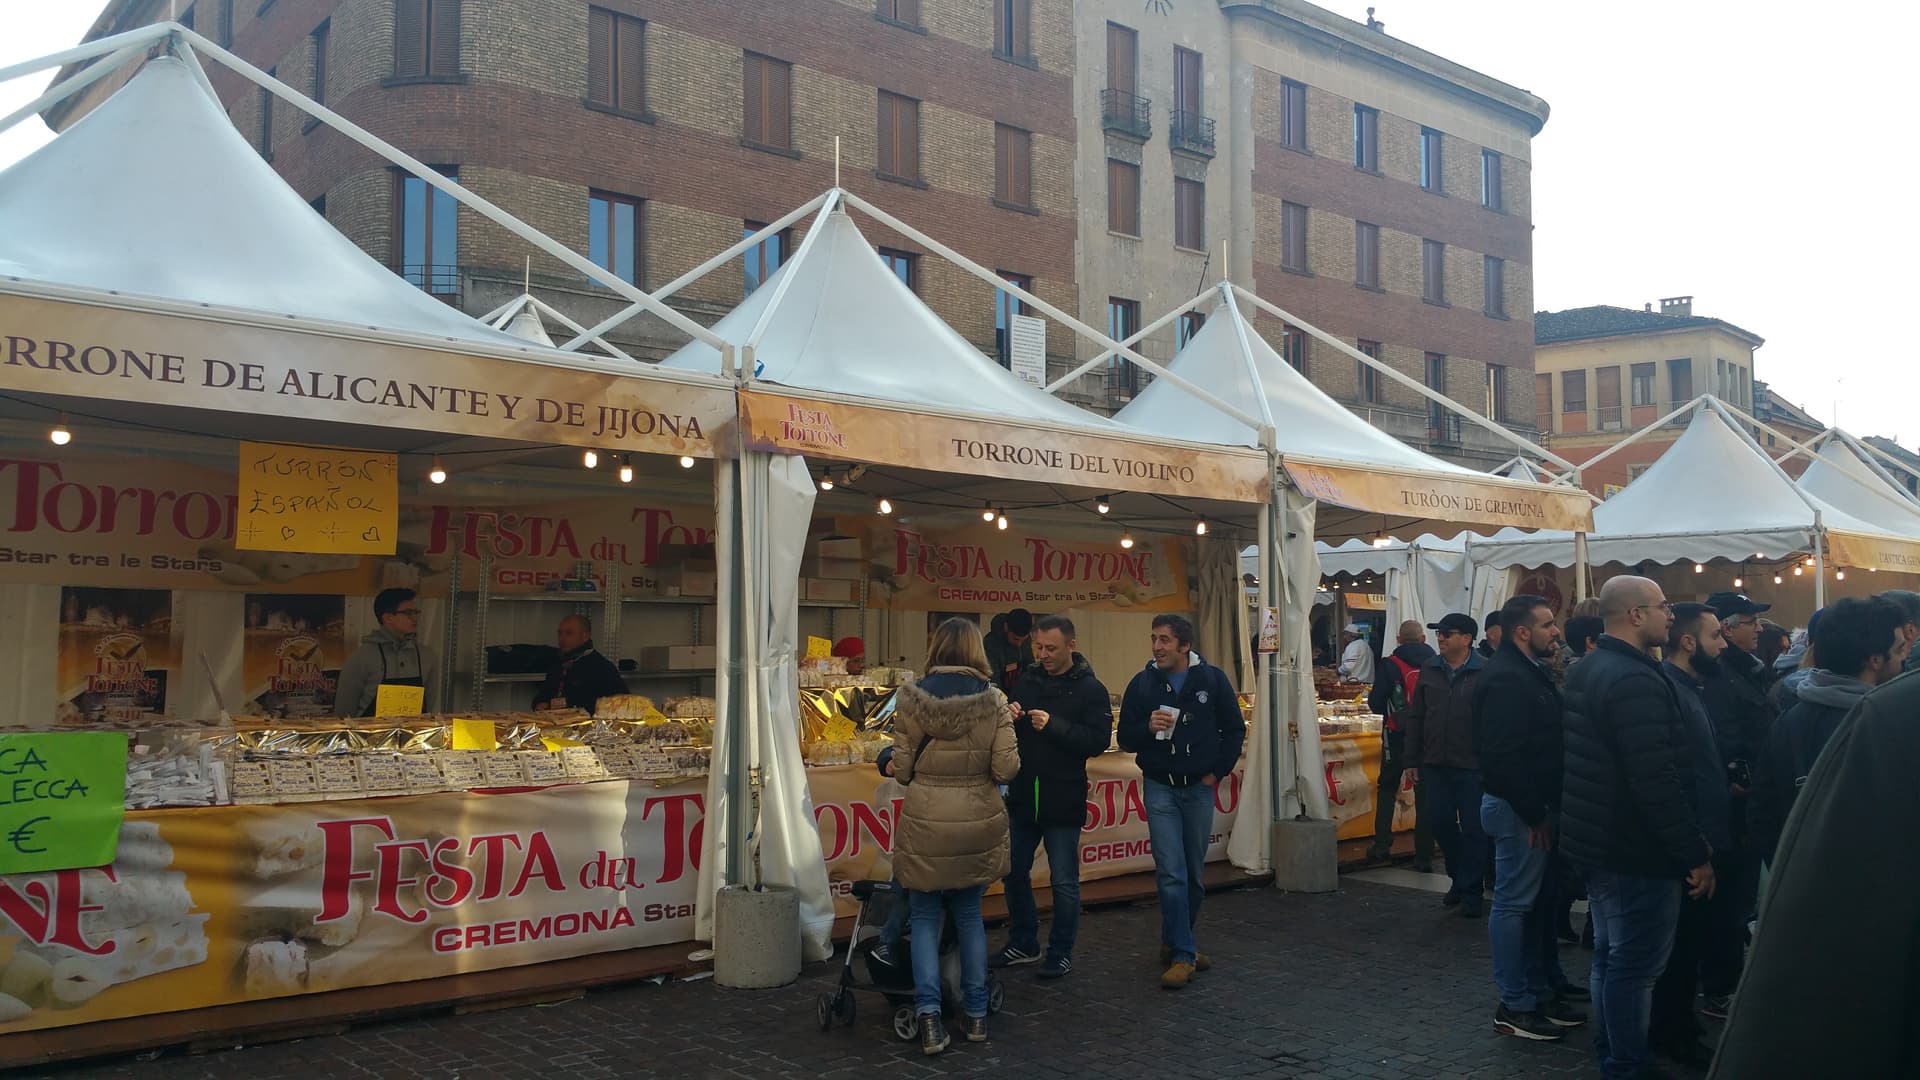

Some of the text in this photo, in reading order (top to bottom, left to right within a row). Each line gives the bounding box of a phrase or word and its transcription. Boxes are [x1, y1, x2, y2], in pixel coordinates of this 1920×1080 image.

[0, 335, 704, 439] RRONE DE ALICANTE Y DE JIJONA
[952, 438, 1194, 483] TORRONE DEL VIOLINO
[1465, 497, 1482, 511] DE
[68, 552, 110, 567] tra
[120, 553, 141, 568] le
[151, 555, 223, 572] Stars
[895, 529, 993, 583] FESTA
[940, 588, 1022, 602] CREMONA
[1025, 591, 1051, 602] Star
[1076, 591, 1087, 602] le
[8, 816, 52, 854] €
[315, 816, 566, 924] FESTA
[436, 906, 635, 953] CREMONA
